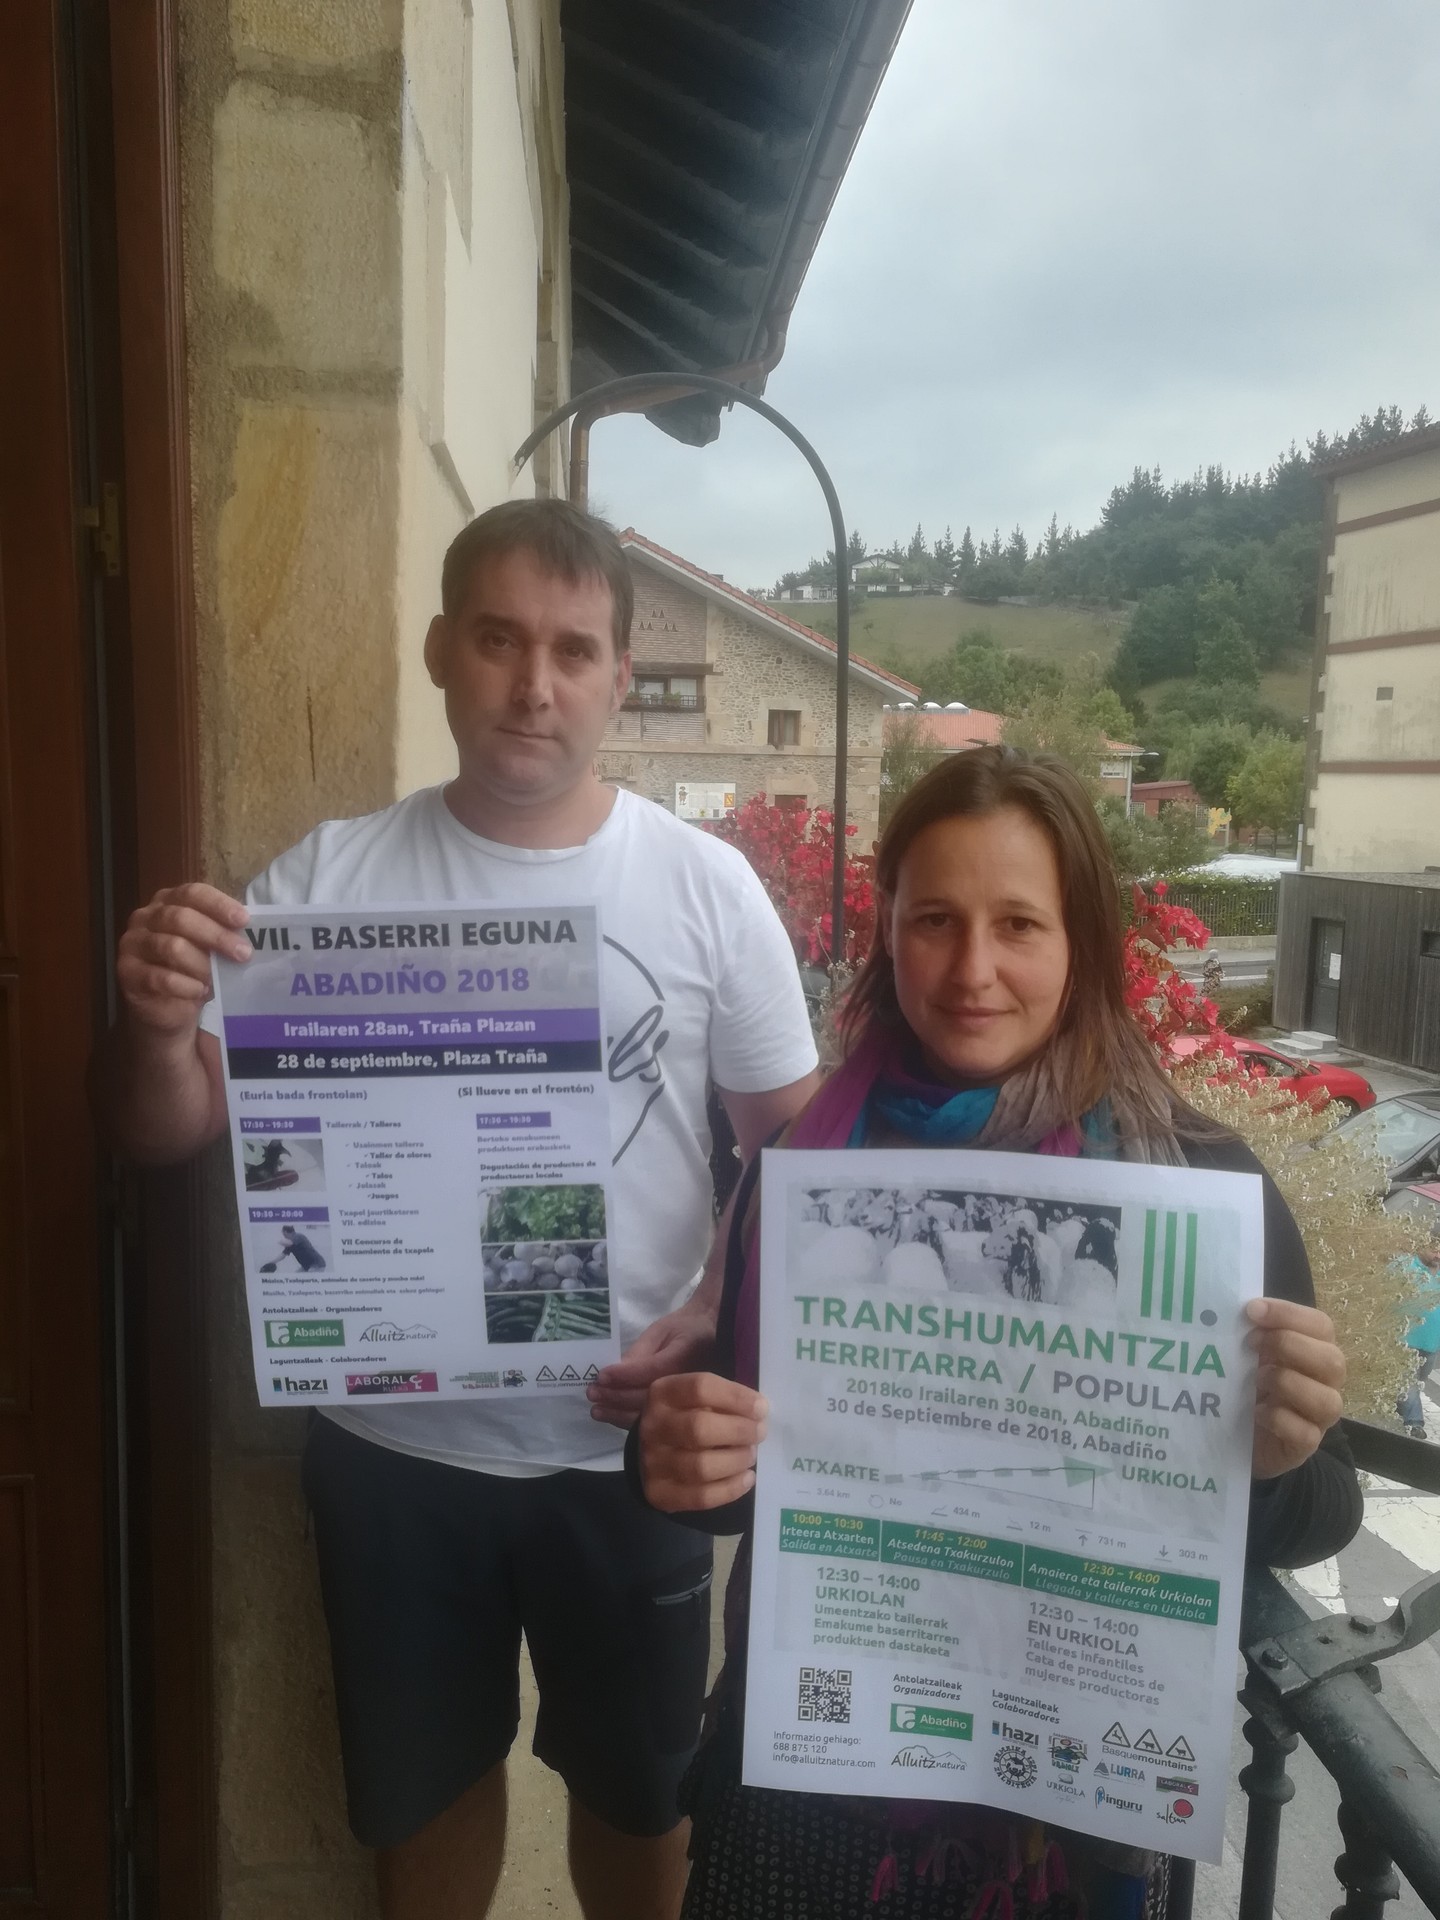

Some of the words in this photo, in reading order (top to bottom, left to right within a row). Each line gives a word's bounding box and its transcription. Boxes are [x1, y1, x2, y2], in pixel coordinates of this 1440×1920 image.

[245, 926, 301, 951] VII.
[312, 923, 450, 950] BASERRI
[462, 919, 577, 946] EGUNA
[290, 964, 446, 996] ABADIÑO
[457, 968, 530, 993] 2018
[284, 1022, 360, 1037] Irailaren
[364, 1021, 414, 1038] 28an,
[419, 1020, 472, 1035] Traña
[477, 1018, 536, 1033] Plazan
[277, 1055, 299, 1069] 28
[303, 1054, 326, 1068] de
[330, 1053, 438, 1072] septiembre,
[444, 1051, 491, 1066] Plaza
[496, 1049, 547, 1064] Traña
[458, 1086, 472, 1098] (Si
[476, 1086, 511, 1096] llueve
[531, 1085, 542, 1094] el
[545, 1085, 595, 1095] frontón)
[294, 1327, 339, 1338] Abadiño
[794, 1295, 1226, 1378] TRANSHUMANTZIA
[285, 1377, 329, 1392] hazi
[346, 1375, 407, 1386] LABORAL
[796, 1337, 1002, 1384] HERRITARRA
[1018, 1364, 1036, 1393] /
[1053, 1369, 1221, 1417] POPULAR
[846, 1378, 913, 1399] 2018ko
[919, 1386, 999, 1410] Irailaren
[1005, 1398, 1067, 1425] 30ean,
[1073, 1410, 1170, 1439] Abadiñon
[827, 1398, 848, 1413] 30
[854, 1400, 876, 1417] de
[882, 1404, 991, 1431] Septiembre
[997, 1419, 1020, 1435] de
[1026, 1423, 1077, 1449] 2018,
[1082, 1435, 1167, 1461] Abadiño
[791, 1457, 880, 1482] ATXARTE
[1122, 1465, 1218, 1494] URKIOLA
[889, 1498, 902, 1506] No
[953, 1507, 969, 1516] 434
[792, 1513, 822, 1526] 10:00
[834, 1517, 864, 1530] 10:30
[1029, 1521, 1041, 1531] 12
[1042, 1524, 1051, 1533] m
[782, 1526, 821, 1538] Irteera
[824, 1530, 874, 1545] Atxarten
[915, 1529, 944, 1542] 11:45
[957, 1535, 987, 1549] 12:00
[1098, 1536, 1114, 1546] 731
[781, 1539, 816, 1551] Salida
[819, 1543, 832, 1552] en
[834, 1544, 878, 1558] Atxarte
[887, 1538, 941, 1555] Atsedena
[944, 1547, 1014, 1568] Txakurzulon
[1178, 1549, 1196, 1559] 303
[893, 1552, 928, 1566] Pausa
[930, 1558, 944, 1567] en
[948, 1560, 1010, 1580] Txakurzulo
[1083, 1562, 1114, 1576] 12:30
[1128, 1571, 1160, 1584] 14:00
[817, 1566, 859, 1583] 12:30
[878, 1574, 920, 1592] 14:00
[1028, 1563, 1078, 1583] Amaiera
[1081, 1576, 1100, 1587] eta
[1103, 1580, 1157, 1598] tailerrak
[1159, 1588, 1212, 1607] Urkiolan
[815, 1586, 905, 1608] URKIOLAN
[1035, 1578, 1082, 1597] Llegada
[1084, 1589, 1092, 1600] y
[1094, 1591, 1140, 1609] talleres
[1143, 1602, 1158, 1612] en
[1161, 1602, 1206, 1620] Urkiola
[815, 1604, 891, 1621] Umeentzako
[894, 1610, 948, 1630] tailerrak
[1030, 1601, 1073, 1623] 12:30
[1093, 1617, 1139, 1638] 14:00
[814, 1618, 873, 1633] Emakume
[877, 1623, 960, 1645] baserritarren
[1028, 1619, 1051, 1636] EN
[1057, 1626, 1139, 1657] URKIOLA
[813, 1633, 885, 1649] produktuen
[888, 1637, 950, 1657] dastaketa
[1026, 1637, 1077, 1658] Talleres
[1081, 1649, 1144, 1673] infantiles
[893, 1674, 962, 1691] Antolatzaileak
[1025, 1651, 1055, 1667] Cata
[1058, 1660, 1073, 1672] de
[1078, 1664, 1145, 1689] productos
[1149, 1679, 1165, 1692] de
[893, 1684, 961, 1701] Organizadores
[1025, 1666, 1076, 1686] mujeres
[1079, 1676, 1160, 1706] productoras
[992, 1689, 1059, 1713] Laguntzaileak
[992, 1700, 1060, 1724] Colaboradores
[919, 1714, 967, 1730] Abadiño
[1002, 1722, 1039, 1745] hazi
[773, 1731, 821, 1743] Informazio
[823, 1735, 861, 1746] gehiago:
[773, 1743, 790, 1751] 688
[791, 1744, 808, 1752] 875
[811, 1745, 827, 1753] 120
[773, 1754, 875, 1768] info@alluitznatura.com
[1110, 1763, 1145, 1781] LURRA
